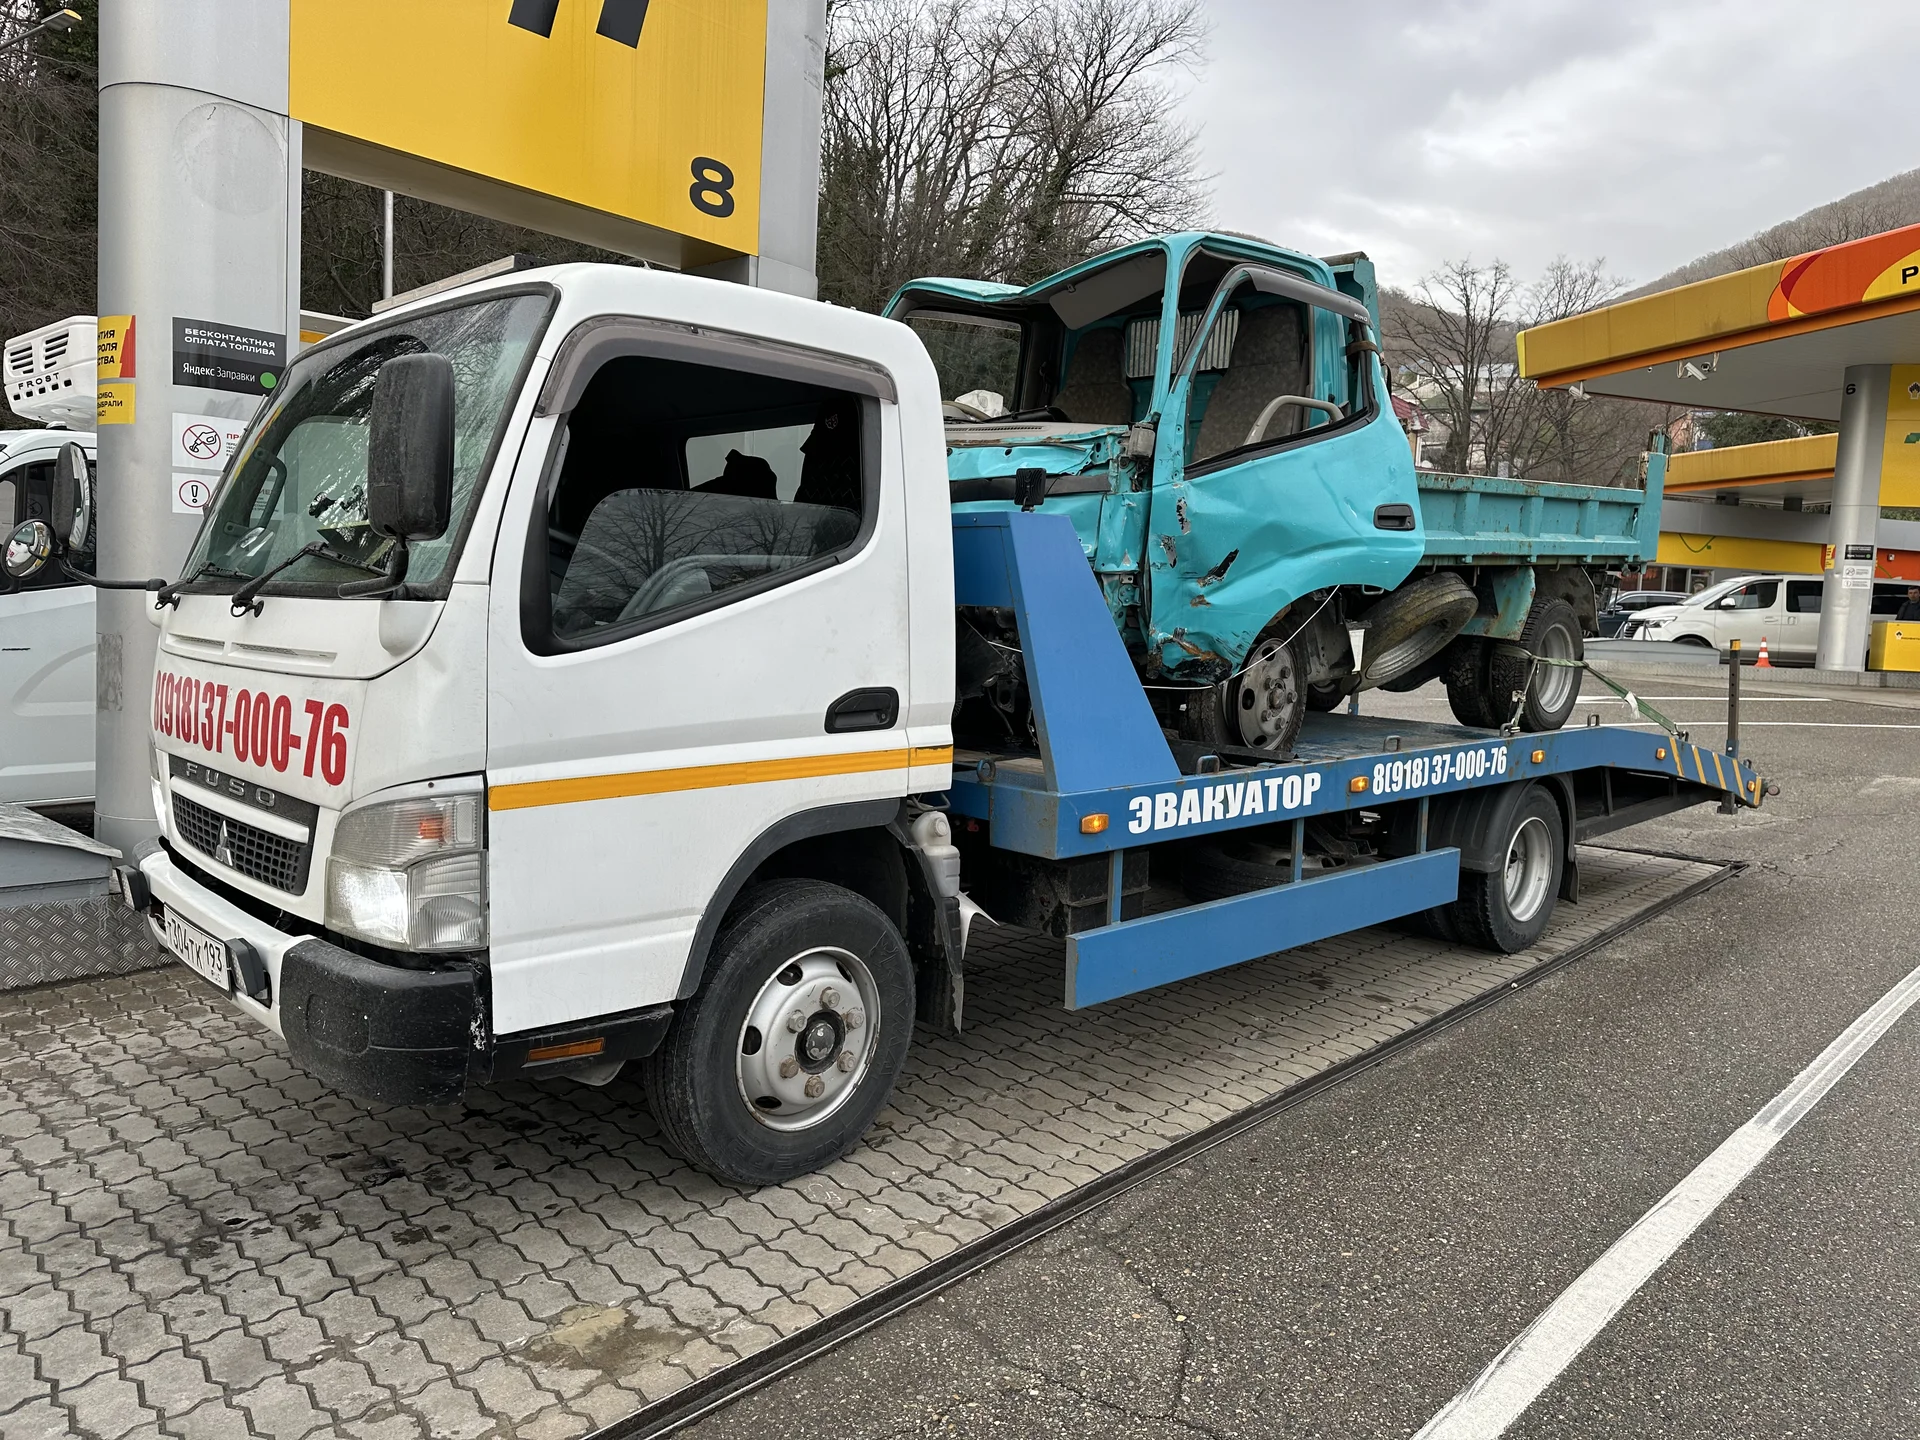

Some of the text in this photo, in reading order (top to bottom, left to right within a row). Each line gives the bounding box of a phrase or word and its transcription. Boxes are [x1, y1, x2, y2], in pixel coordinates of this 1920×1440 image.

[689, 157, 735, 218] 8
[184, 327, 276, 349] БЕСКОНТАКТНАЯ
[184, 336, 276, 357] ОПЛАТА ТОПЛИВА
[18, 372, 60, 390] FROST
[182, 362, 256, 383] Яндекс Заправки
[1845, 383, 1857, 396] 6
[1431, 747, 1508, 785] 37-000-76
[186, 762, 275, 807] FUSO
[1128, 772, 1321, 834] ЭВАКУАТОР
[204, 940, 223, 972] 193
